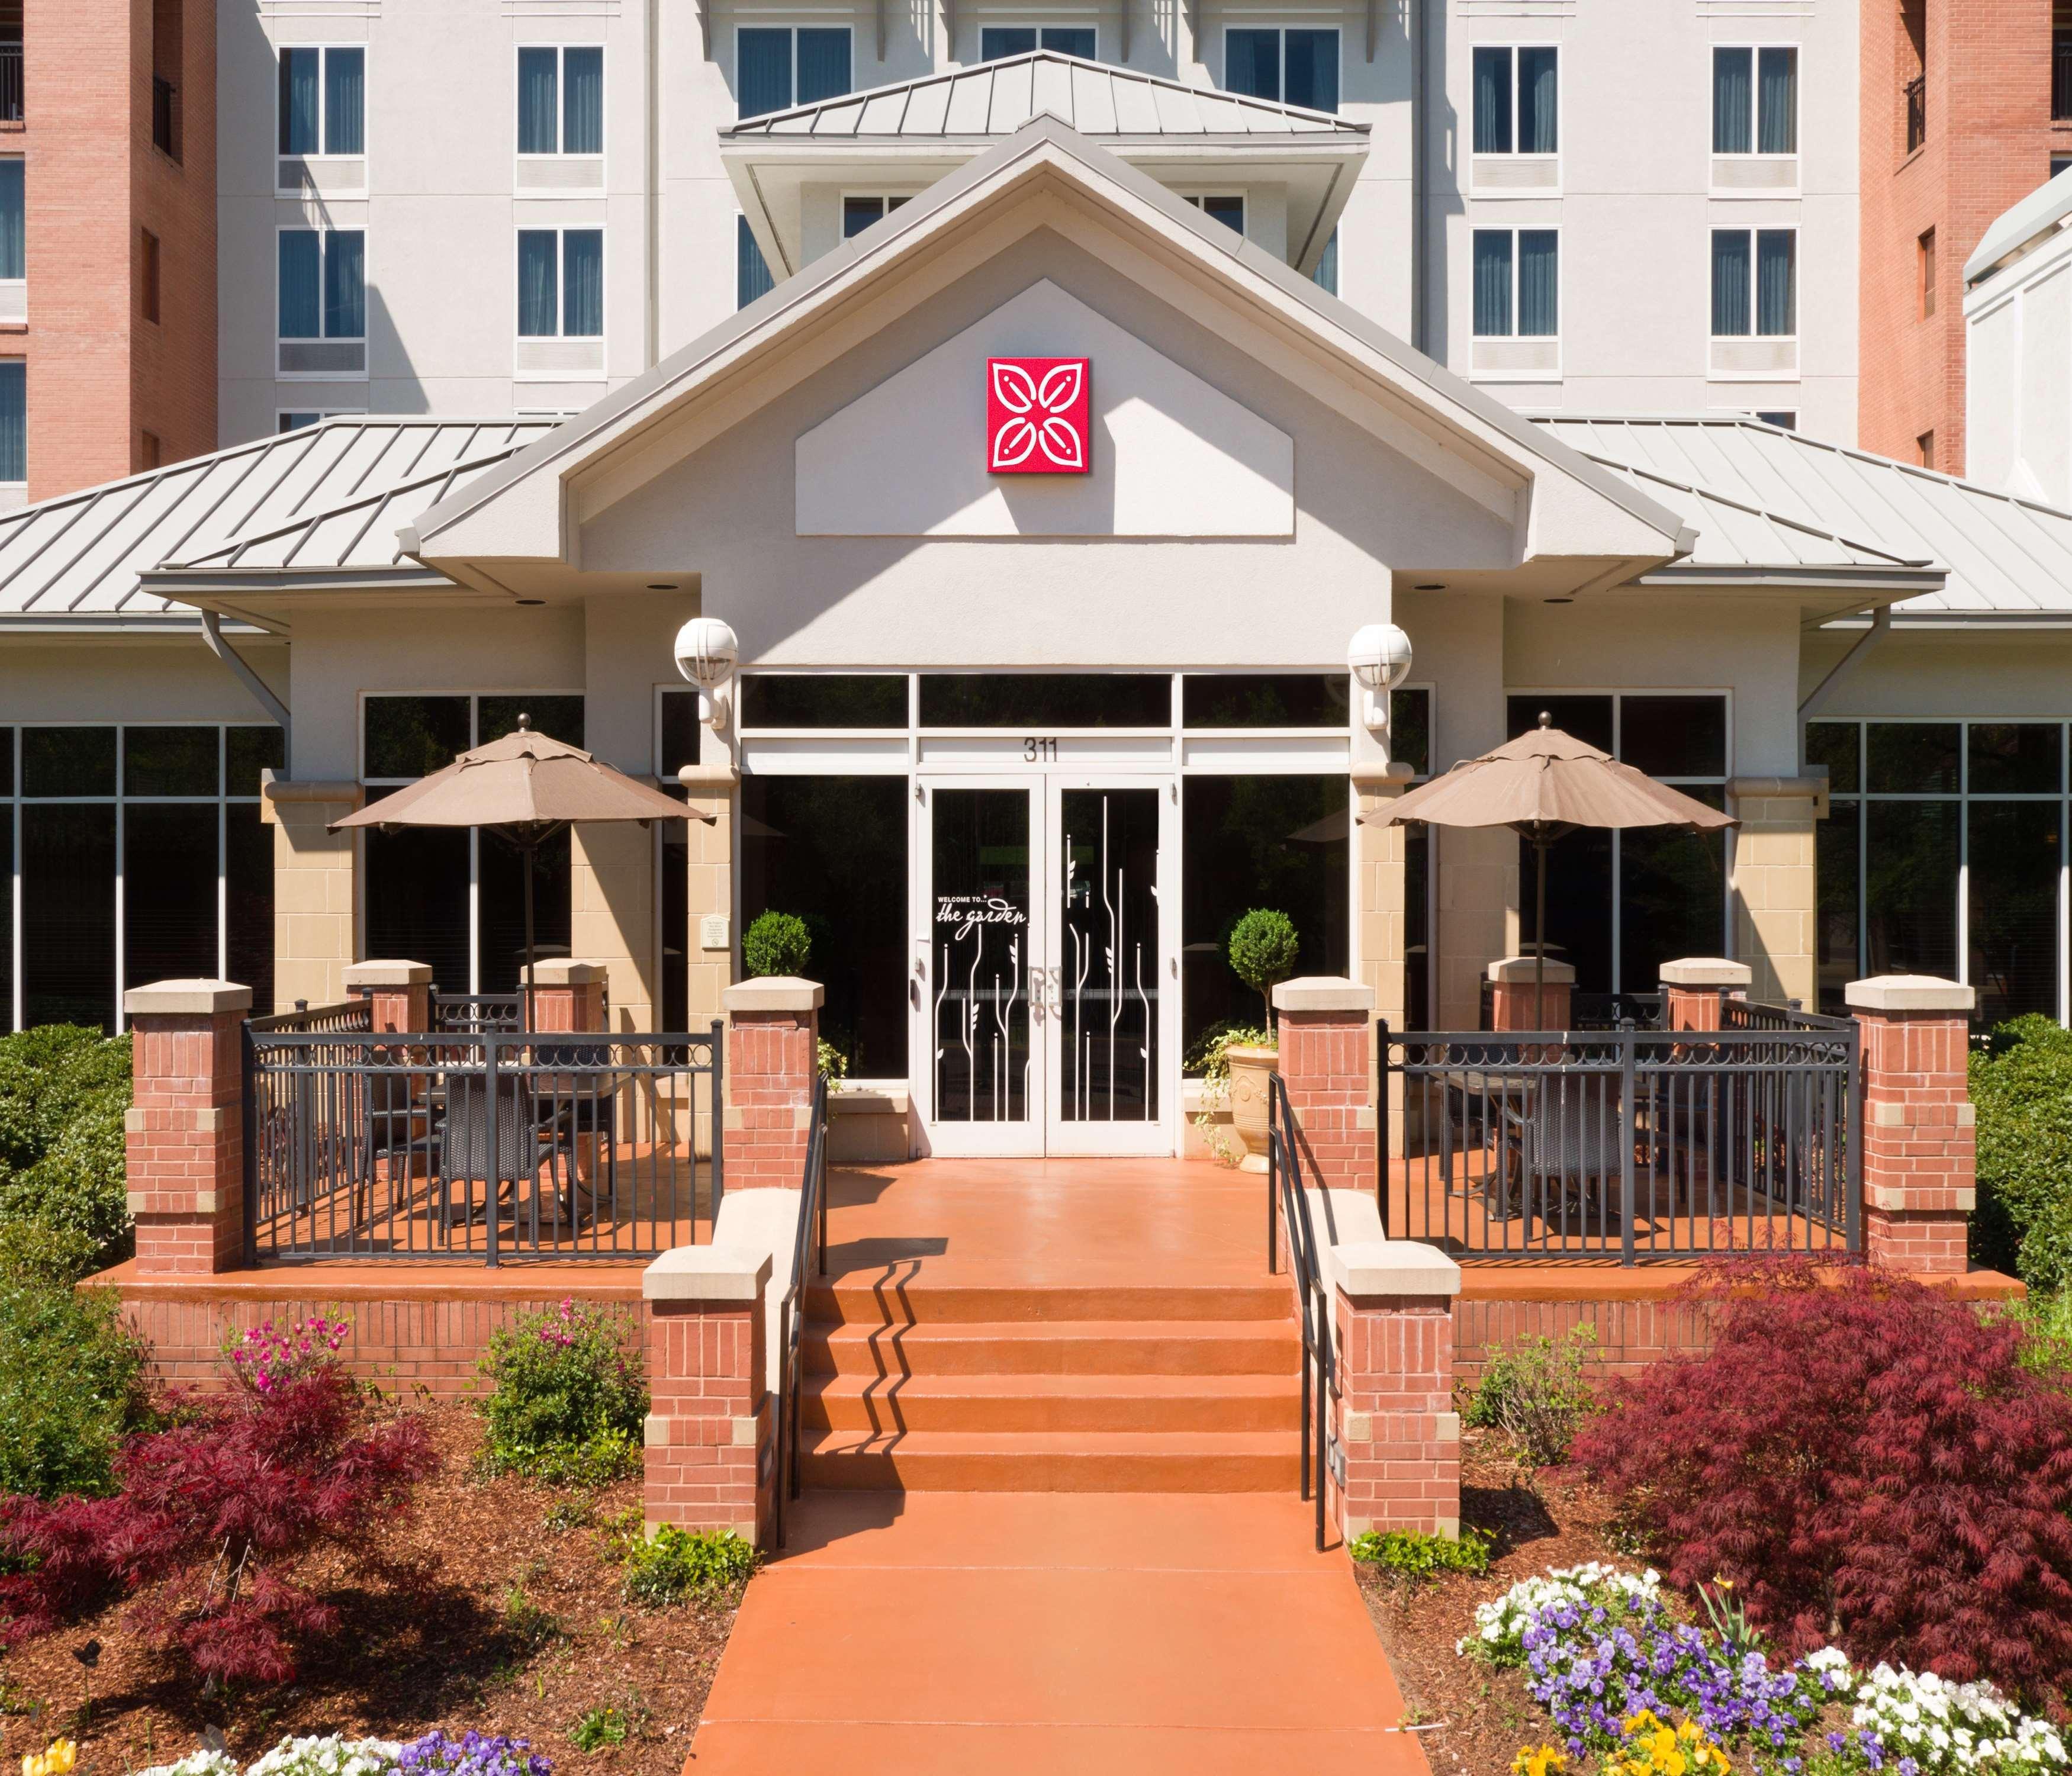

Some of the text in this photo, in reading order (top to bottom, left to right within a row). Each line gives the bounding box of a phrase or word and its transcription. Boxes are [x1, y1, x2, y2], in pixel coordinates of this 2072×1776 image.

[1024, 737, 1057, 762] 311
[936, 898, 1026, 941] the garden
